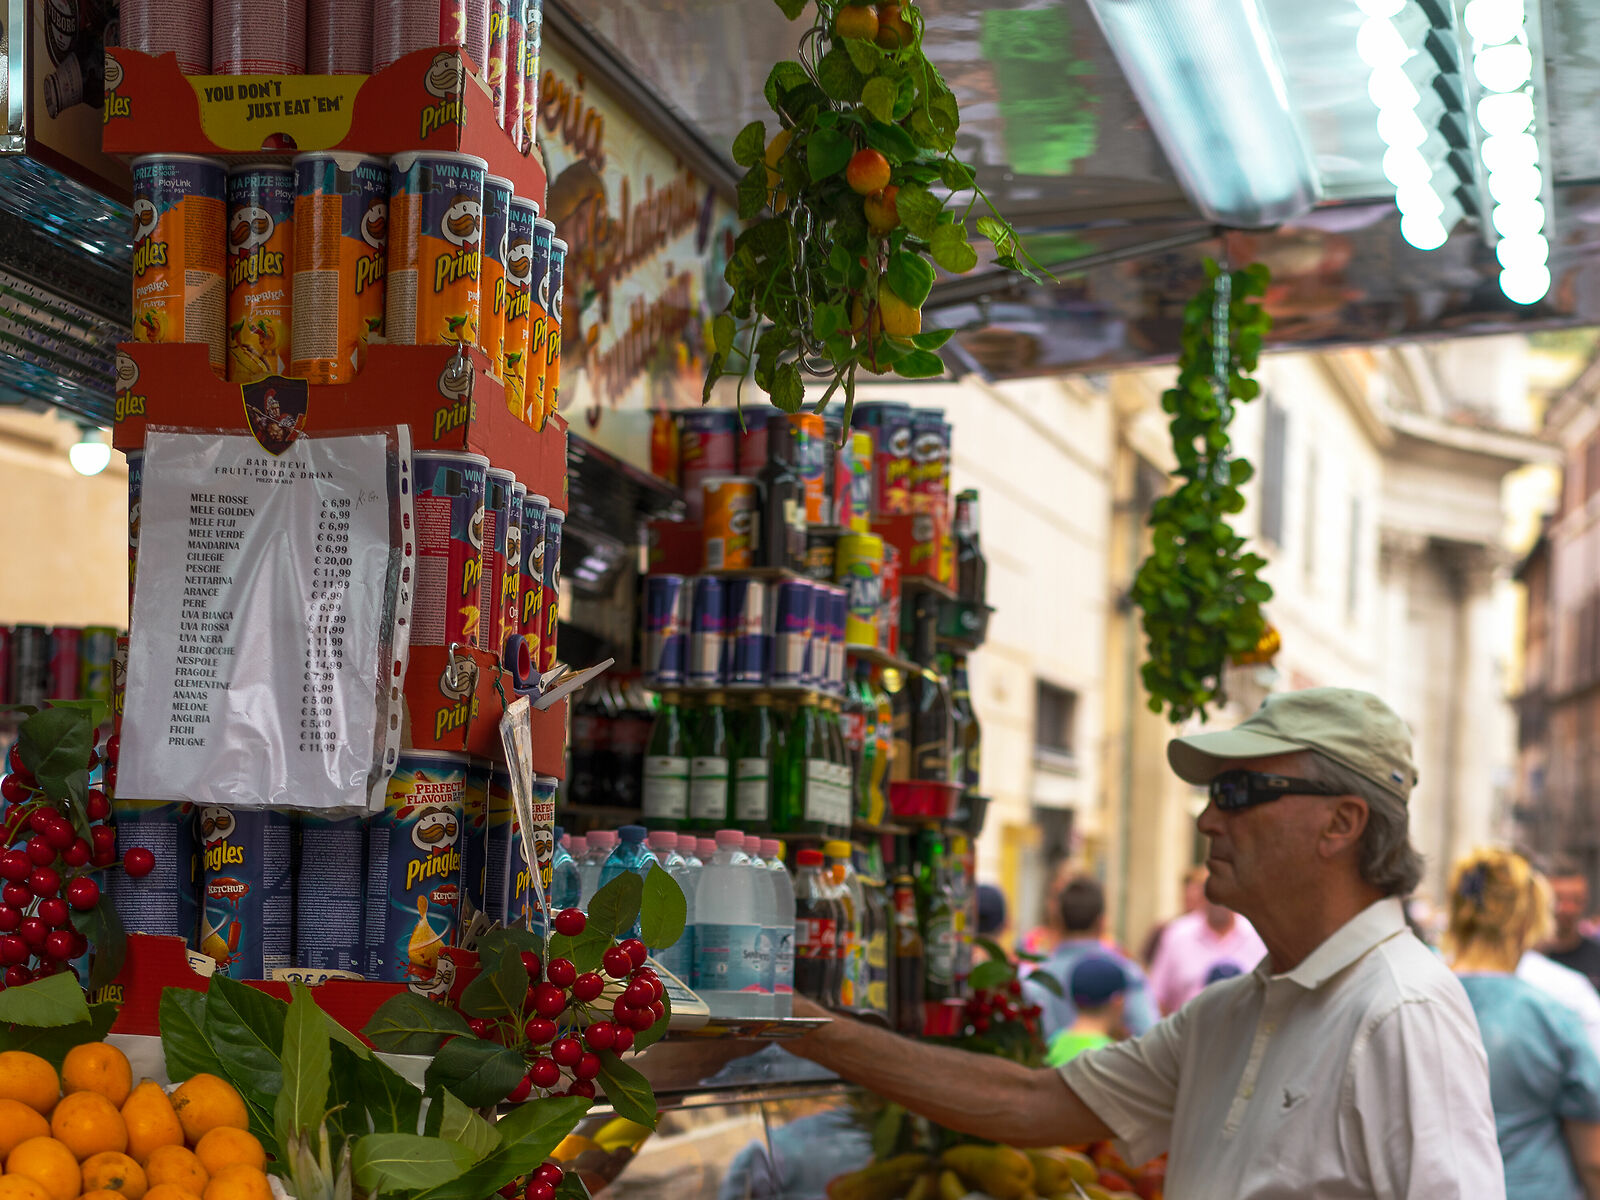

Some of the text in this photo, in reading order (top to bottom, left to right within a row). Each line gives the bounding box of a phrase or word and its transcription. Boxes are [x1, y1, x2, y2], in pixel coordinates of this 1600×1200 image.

[204, 80, 282, 103] YOU DON'T
[246, 102, 281, 121] JUST
[284, 98, 311, 115] EAT
[135, 165, 158, 181] PRIZE
[355, 166, 376, 180] WIN
[435, 165, 460, 178] WIN
[461, 168, 469, 179] A
[158, 179, 191, 188] PlayLink
[244, 176, 274, 187] PRIZE
[136, 280, 169, 298] PAPRIKA
[244, 290, 285, 304] PAPRIKA
[246, 458, 306, 469] BAR TREVI
[289, 471, 296, 479] &
[300, 471, 334, 479] DRINK
[464, 469, 481, 482] WIN
[191, 493, 248, 504] MELE ROSSE
[331, 499, 350, 508] 6,99
[190, 505, 255, 516] MELE GOLDEN
[525, 507, 540, 520] WIN
[330, 511, 350, 520] 6,99
[190, 517, 236, 527] MELE FUJI
[319, 522, 349, 531] € 6,99
[189, 529, 245, 539] MELE VERDE
[318, 533, 349, 542] € 6,99
[188, 540, 240, 550] MANDARINA
[325, 545, 347, 554] 6,99
[187, 552, 224, 561] CILIEGIE
[315, 556, 352, 566] € 20,00
[186, 564, 221, 573] PESCHE
[314, 568, 351, 578] € 11,99
[184, 576, 232, 584] NETTARINA
[313, 580, 319, 588] €
[184, 587, 219, 596] ARANCE
[312, 591, 342, 600] € 6,99
[183, 599, 206, 607] PERE
[320, 603, 341, 611] 6,99
[182, 610, 233, 620] UVA BIANCA
[180, 622, 229, 631] UVA ROSSA
[317, 626, 344, 635] 11,99
[180, 634, 223, 643] UVA NERA
[177, 645, 235, 655] ALBICOCCHE
[176, 656, 218, 666] NESPOLE
[175, 668, 217, 677] FRAGOLE
[304, 672, 310, 680] €
[174, 679, 232, 690] CLEMENTINE
[303, 684, 333, 693] € 6,99
[173, 691, 208, 699] ANANAS
[302, 696, 309, 704] €
[172, 703, 208, 711] MELONE
[302, 708, 307, 716] €
[171, 714, 210, 723] ANGURIA
[301, 720, 307, 728] €
[170, 726, 194, 734] FICHI
[301, 731, 307, 739] €
[169, 737, 206, 746] PRUGNE
[300, 744, 306, 752] €
[415, 782, 462, 795] PERFECT
[406, 794, 453, 805] FLAVOUR
[207, 885, 245, 895] KETCHUP
